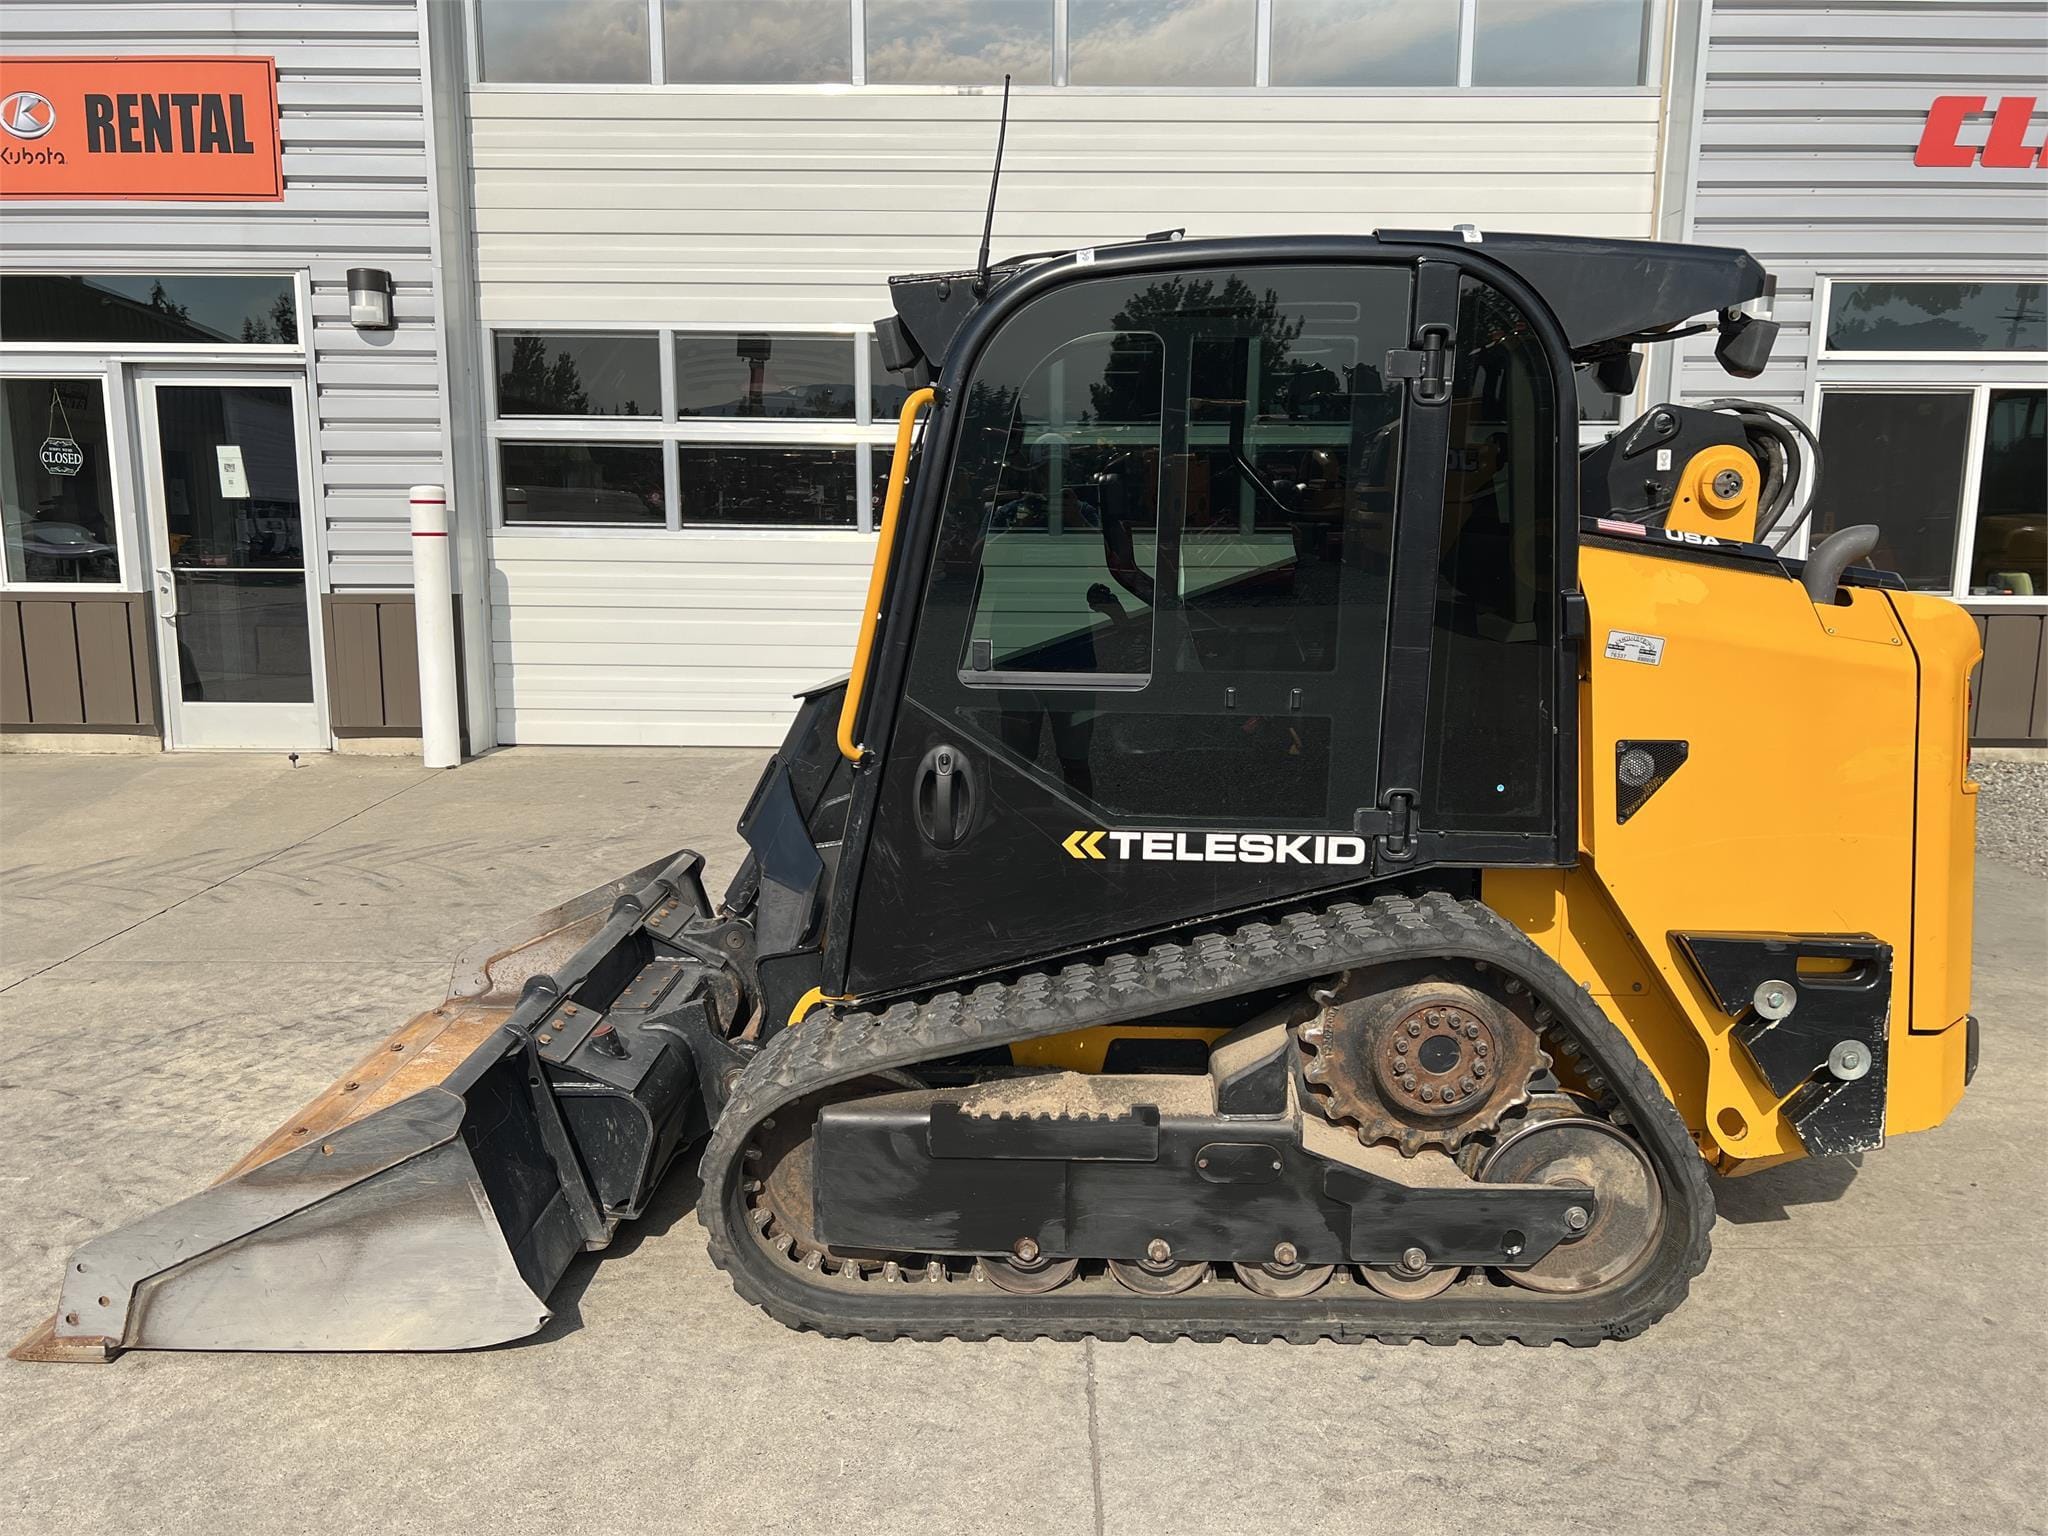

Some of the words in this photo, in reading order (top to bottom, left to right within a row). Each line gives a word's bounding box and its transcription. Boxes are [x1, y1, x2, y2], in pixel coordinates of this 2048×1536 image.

[84, 93, 254, 154] RENTAL
[1913, 95, 2048, 168] CL
[0, 146, 65, 165] Kubota
[42, 451, 82, 465] CLOSED
[1665, 529, 1721, 546] USA
[1109, 831, 1366, 865] TELESKID
